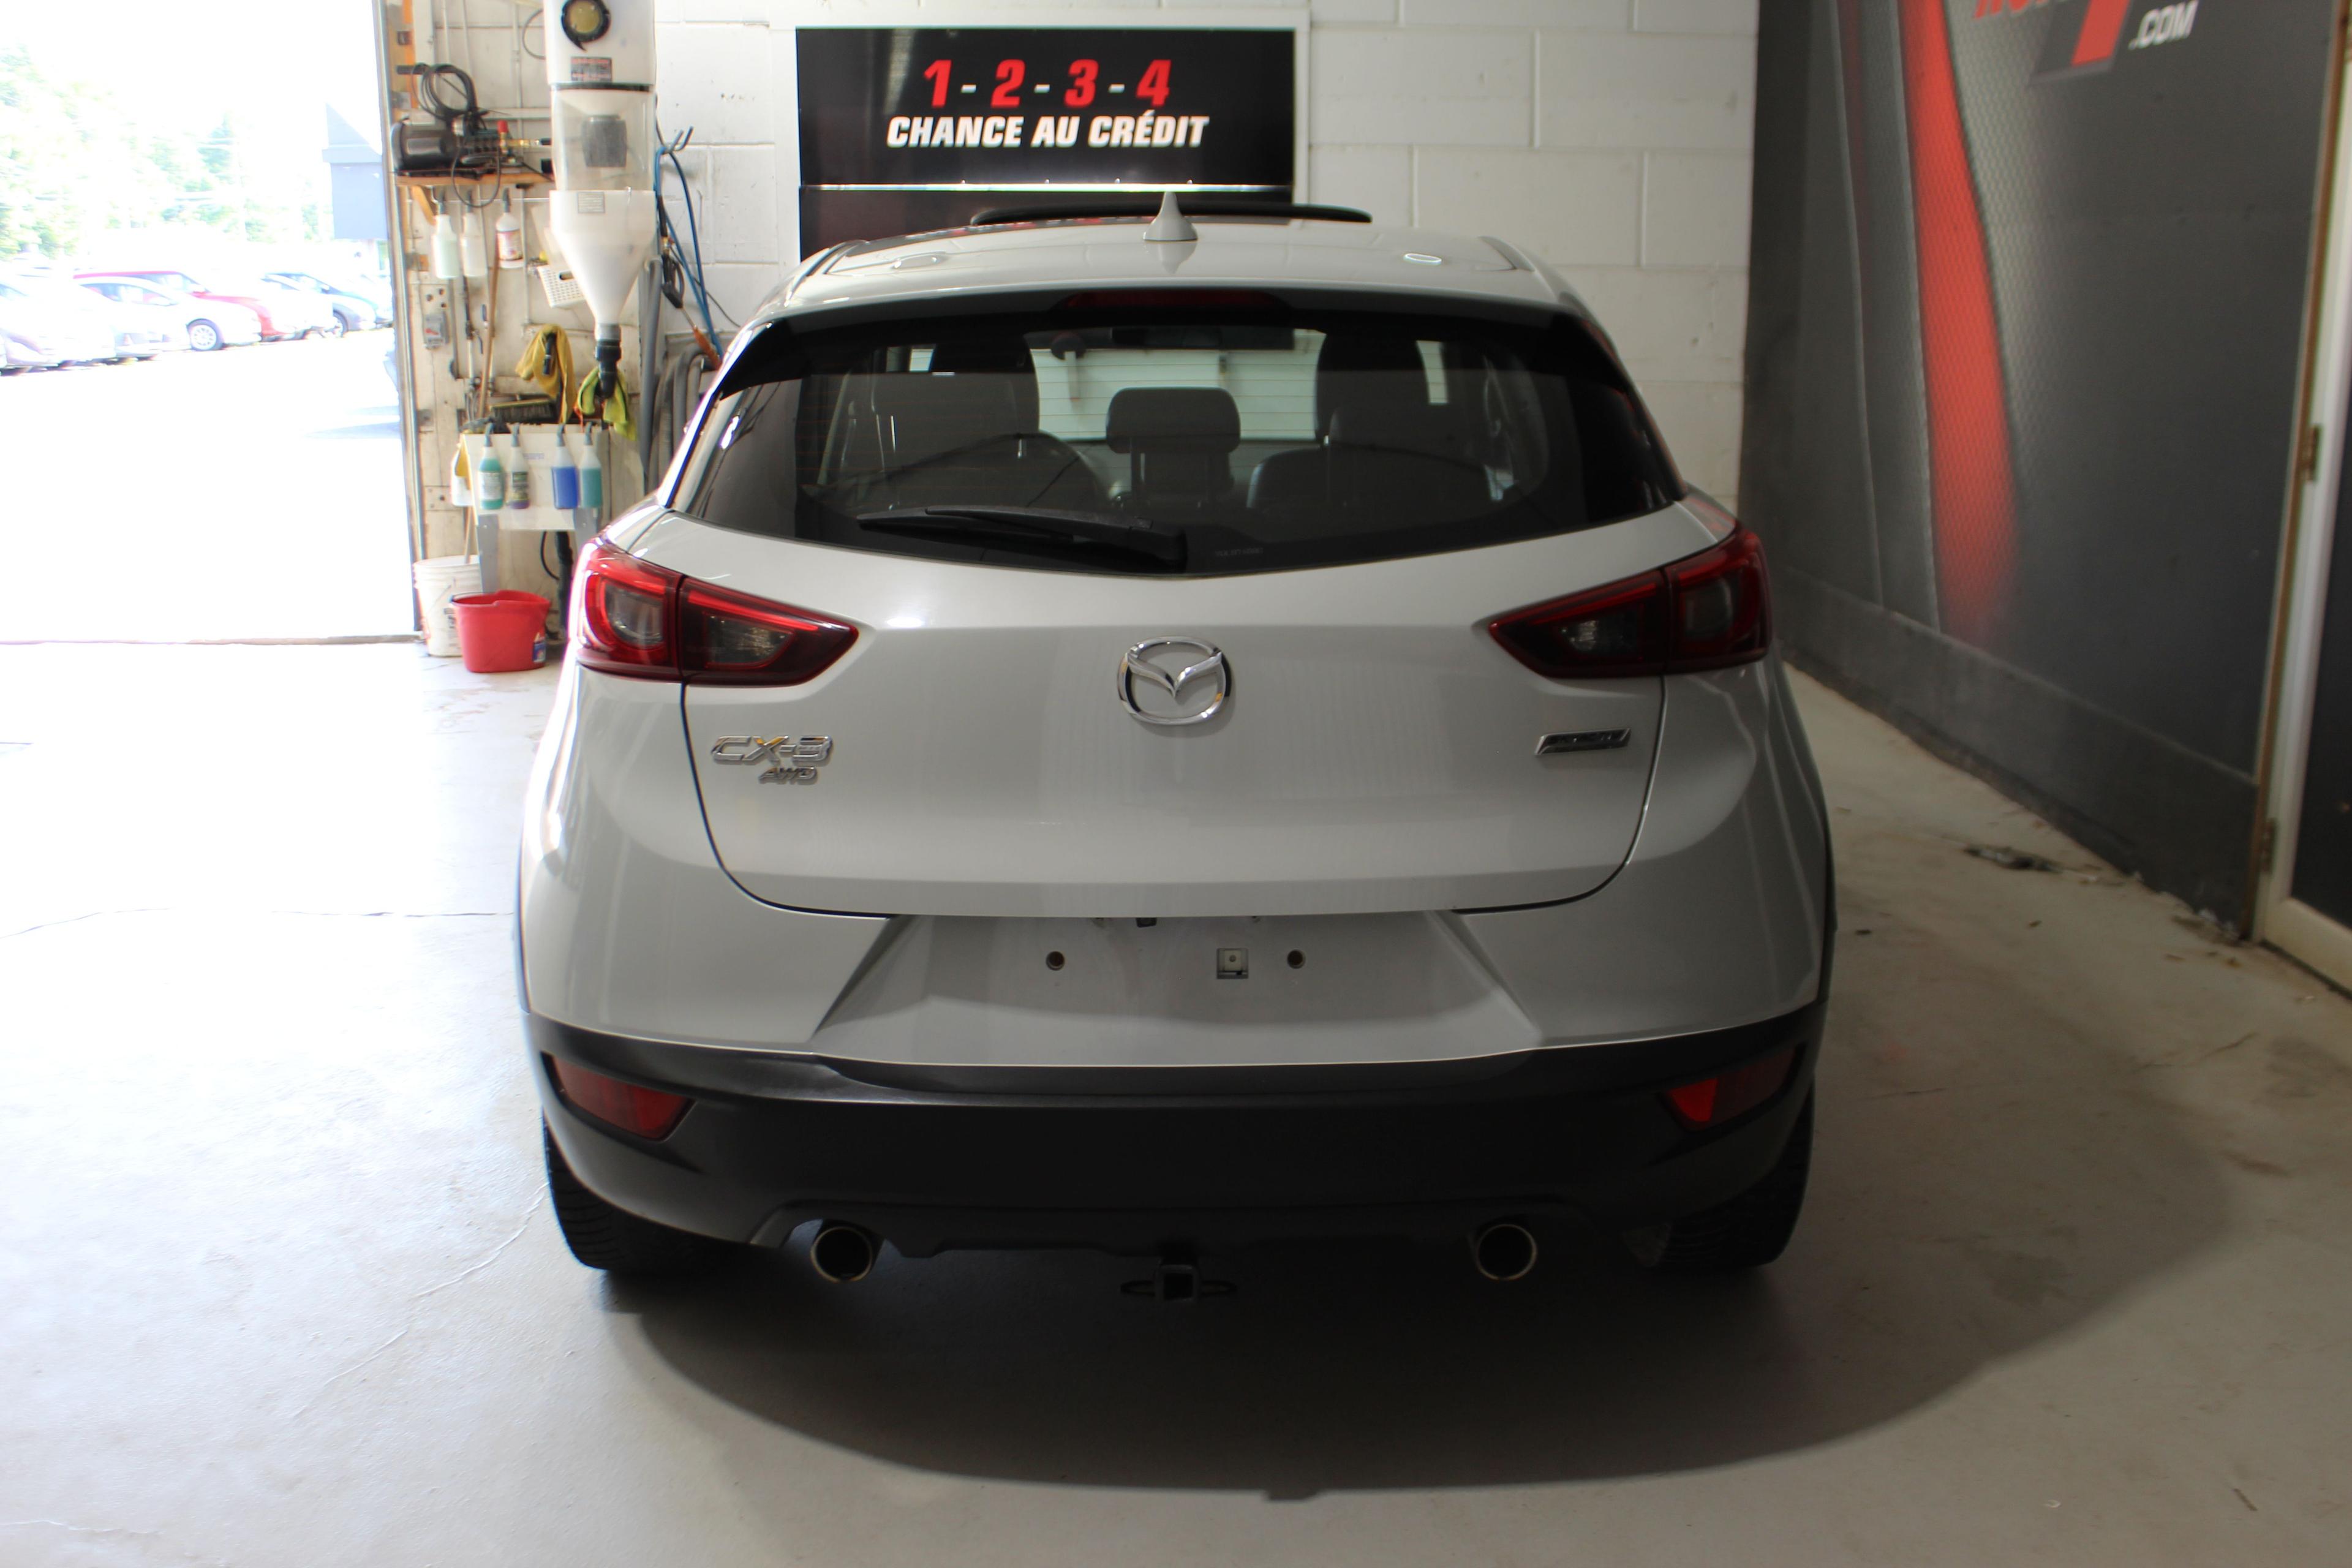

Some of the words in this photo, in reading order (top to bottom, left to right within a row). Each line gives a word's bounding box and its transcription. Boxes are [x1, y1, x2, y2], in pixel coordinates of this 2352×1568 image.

[2128, 0, 2199, 50] .COM
[886, 115, 1025, 148] CHANCE
[1030, 115, 1081, 148] AU
[1087, 108, 1210, 148] CRÉDIT
[711, 735, 833, 763] CX-3
[758, 766, 817, 782] AWD
